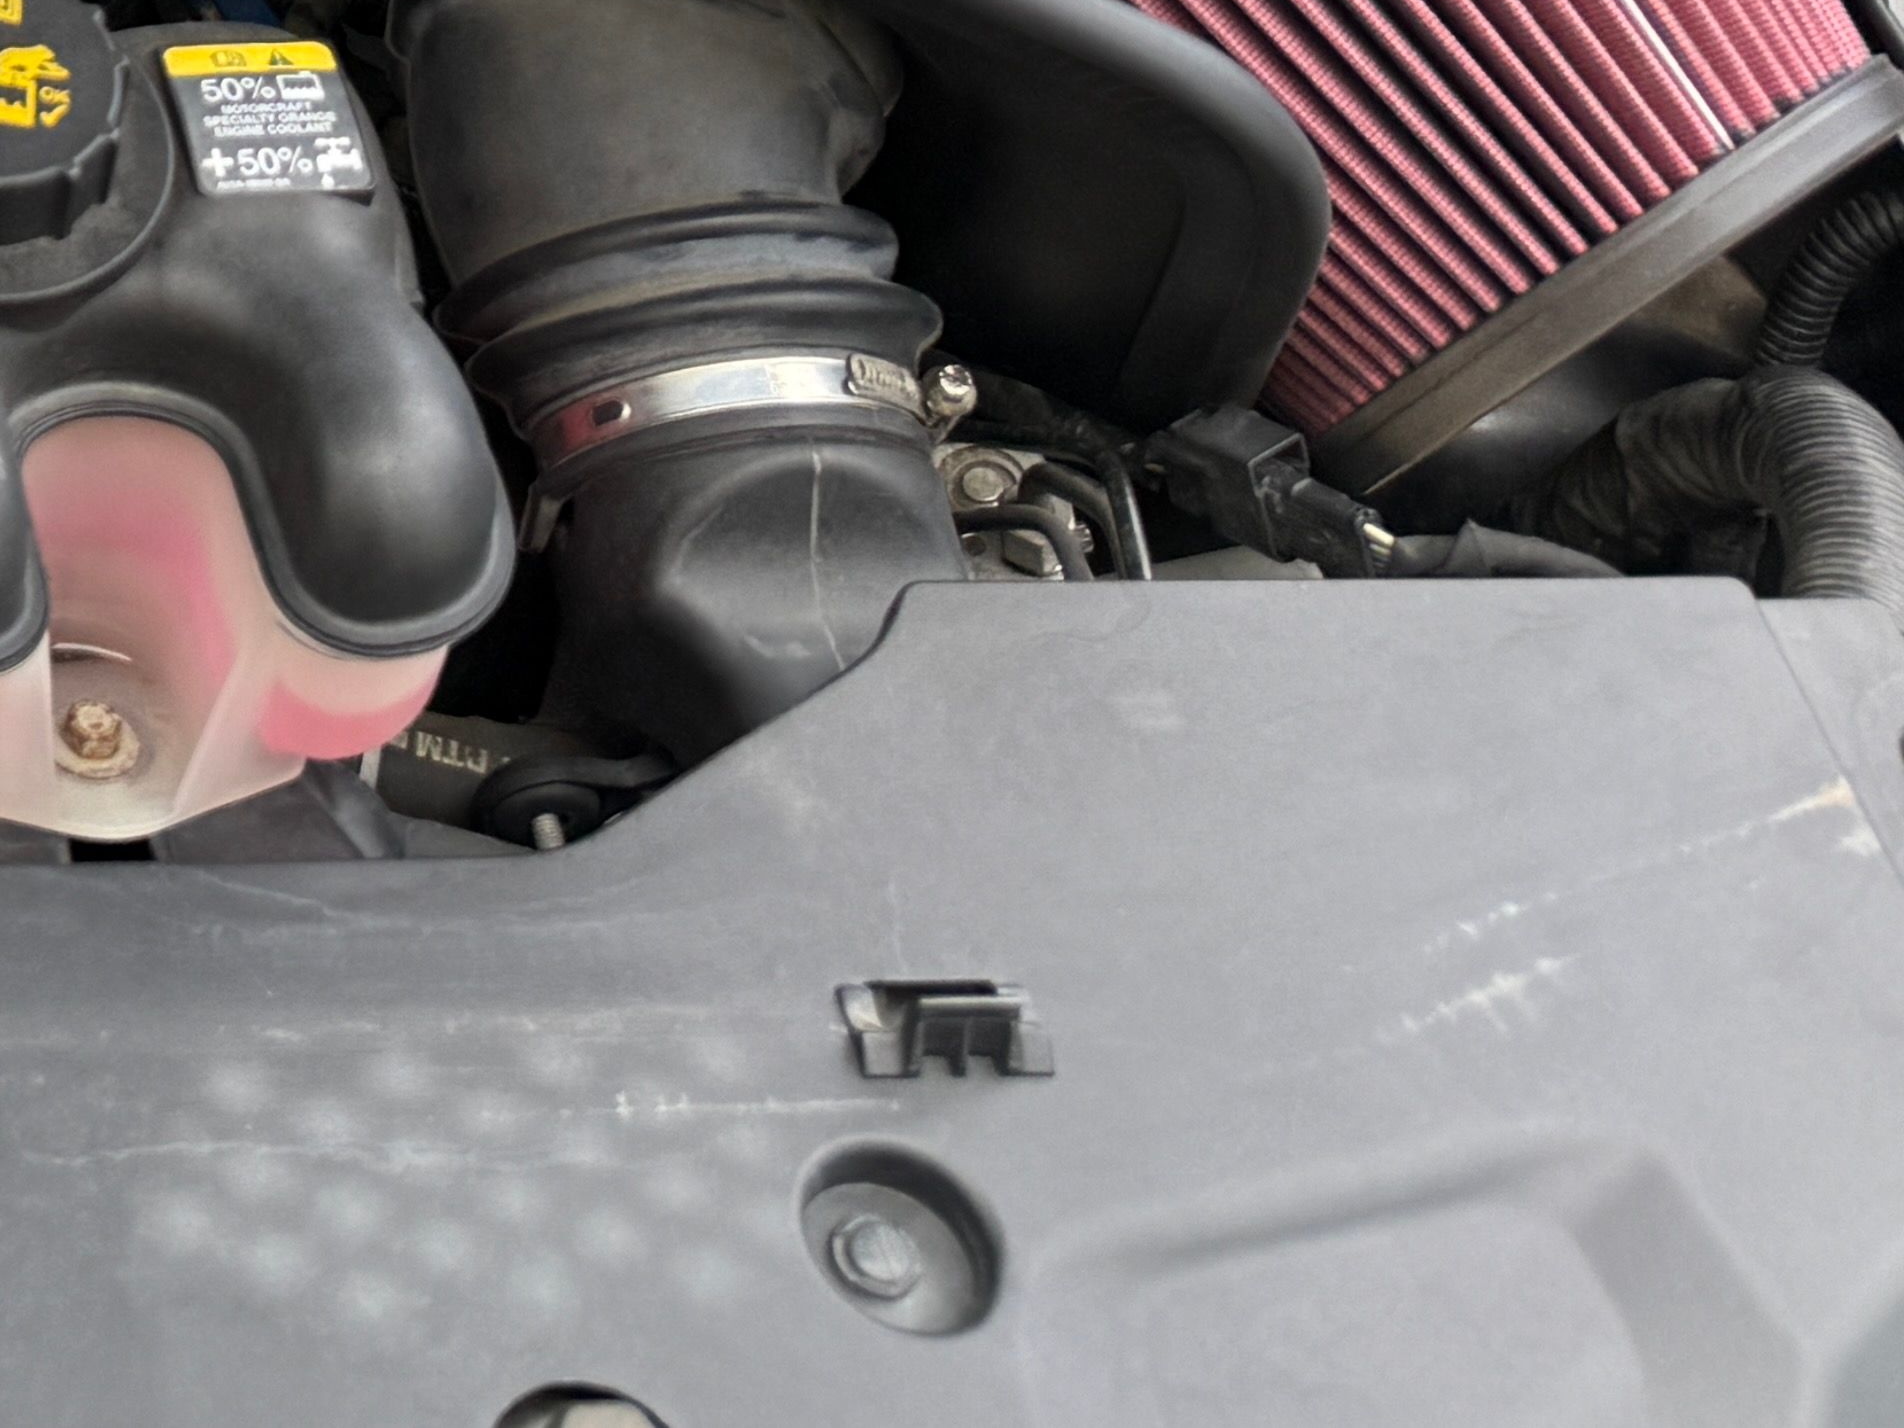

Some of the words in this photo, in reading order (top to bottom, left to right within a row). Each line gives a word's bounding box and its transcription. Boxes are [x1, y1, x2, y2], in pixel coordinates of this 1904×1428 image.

[200, 75, 277, 103] 50%
[219, 101, 313, 115] MOTORCRAFT
[202, 113, 277, 127] SPECIALTY
[278, 110, 338, 124] ORANGE
[267, 121, 333, 135] COOLANT
